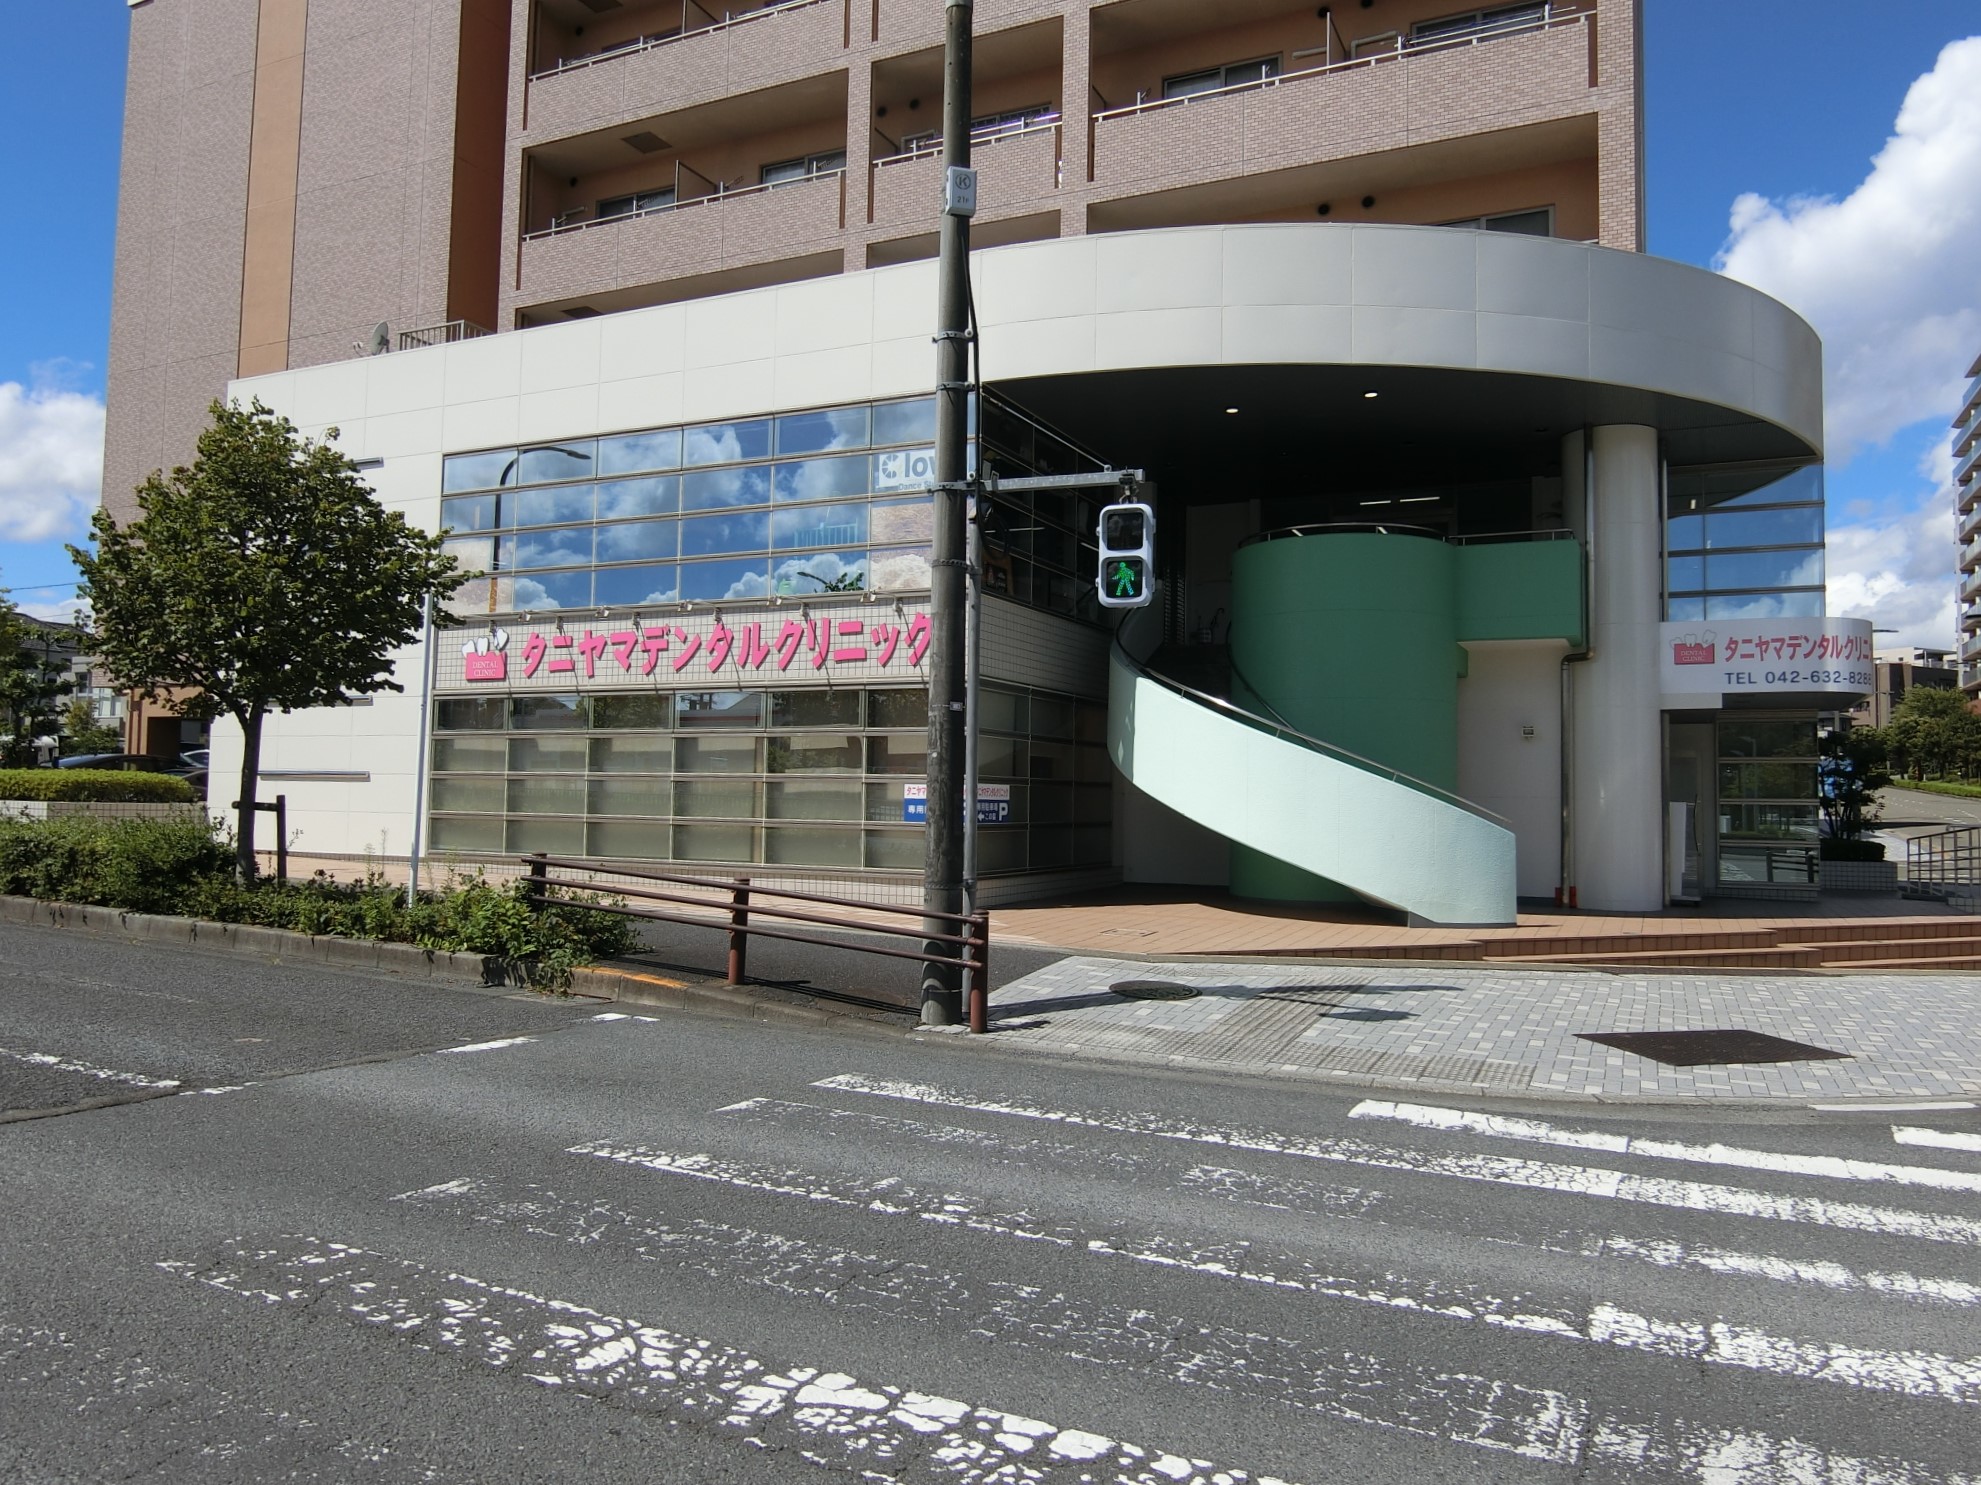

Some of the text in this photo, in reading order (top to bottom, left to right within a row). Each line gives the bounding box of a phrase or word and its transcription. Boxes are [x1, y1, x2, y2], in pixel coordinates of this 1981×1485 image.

[521, 612, 932, 680] タニヤマデンタルクリニック
[1724, 634, 1871, 663] タニヤマデンタルクリニ
[472, 661, 498, 669] DENTAL
[473, 669, 496, 677] CLINIC
[1724, 672, 1757, 685] TEL
[999, 802, 1008, 821] P
